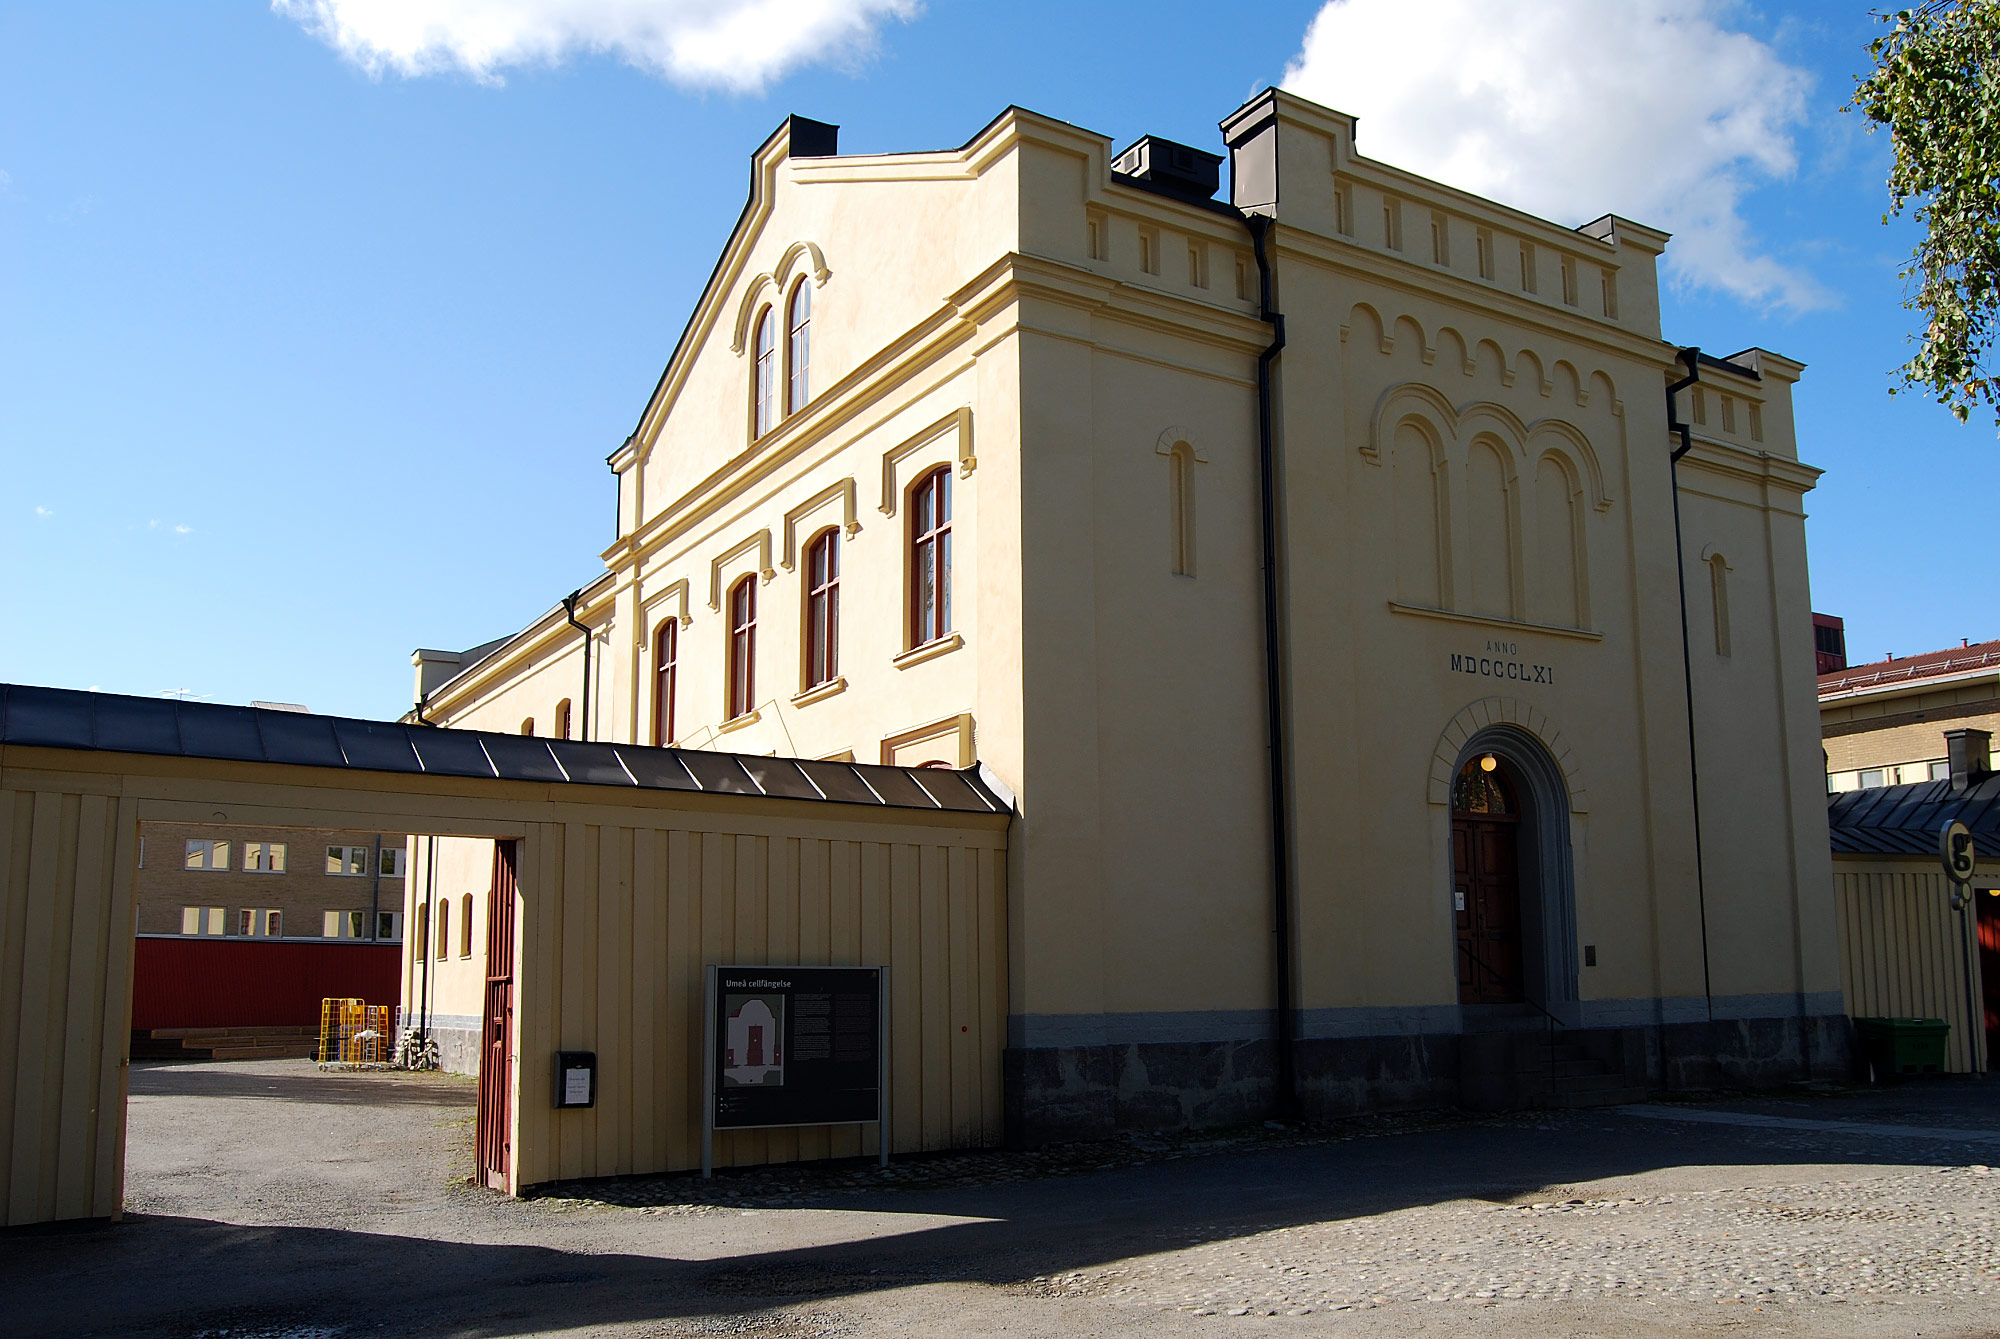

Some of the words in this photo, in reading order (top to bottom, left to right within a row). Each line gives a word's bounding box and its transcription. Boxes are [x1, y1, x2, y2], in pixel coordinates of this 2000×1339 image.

[1486, 640, 1517, 655] ANNO
[1451, 654, 1553, 684] MDCCCLXI
[1953, 833, 1971, 871] g
[726, 979, 746, 987] Umeå
[748, 979, 791, 988] cellfängelse
